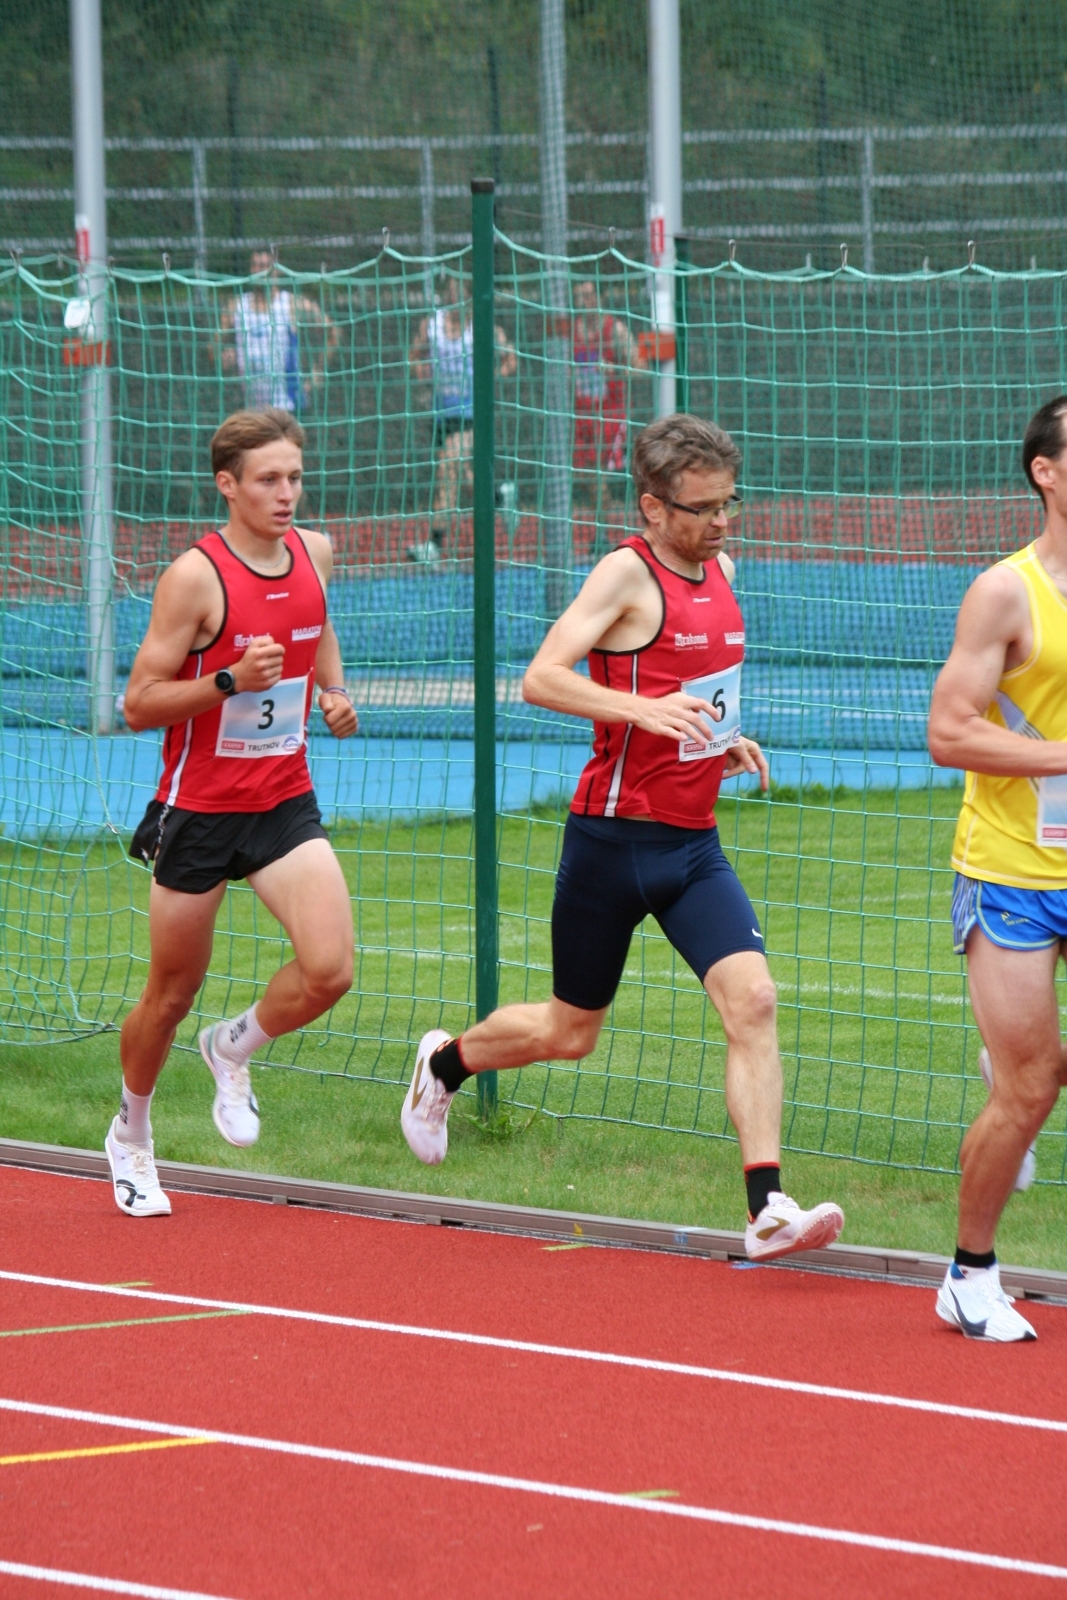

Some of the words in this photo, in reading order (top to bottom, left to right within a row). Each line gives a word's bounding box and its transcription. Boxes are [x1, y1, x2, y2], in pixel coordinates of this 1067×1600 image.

[257, 698, 275, 730] 3
[712, 687, 726, 723] 6
[247, 742, 280, 752] TRUTNOV
